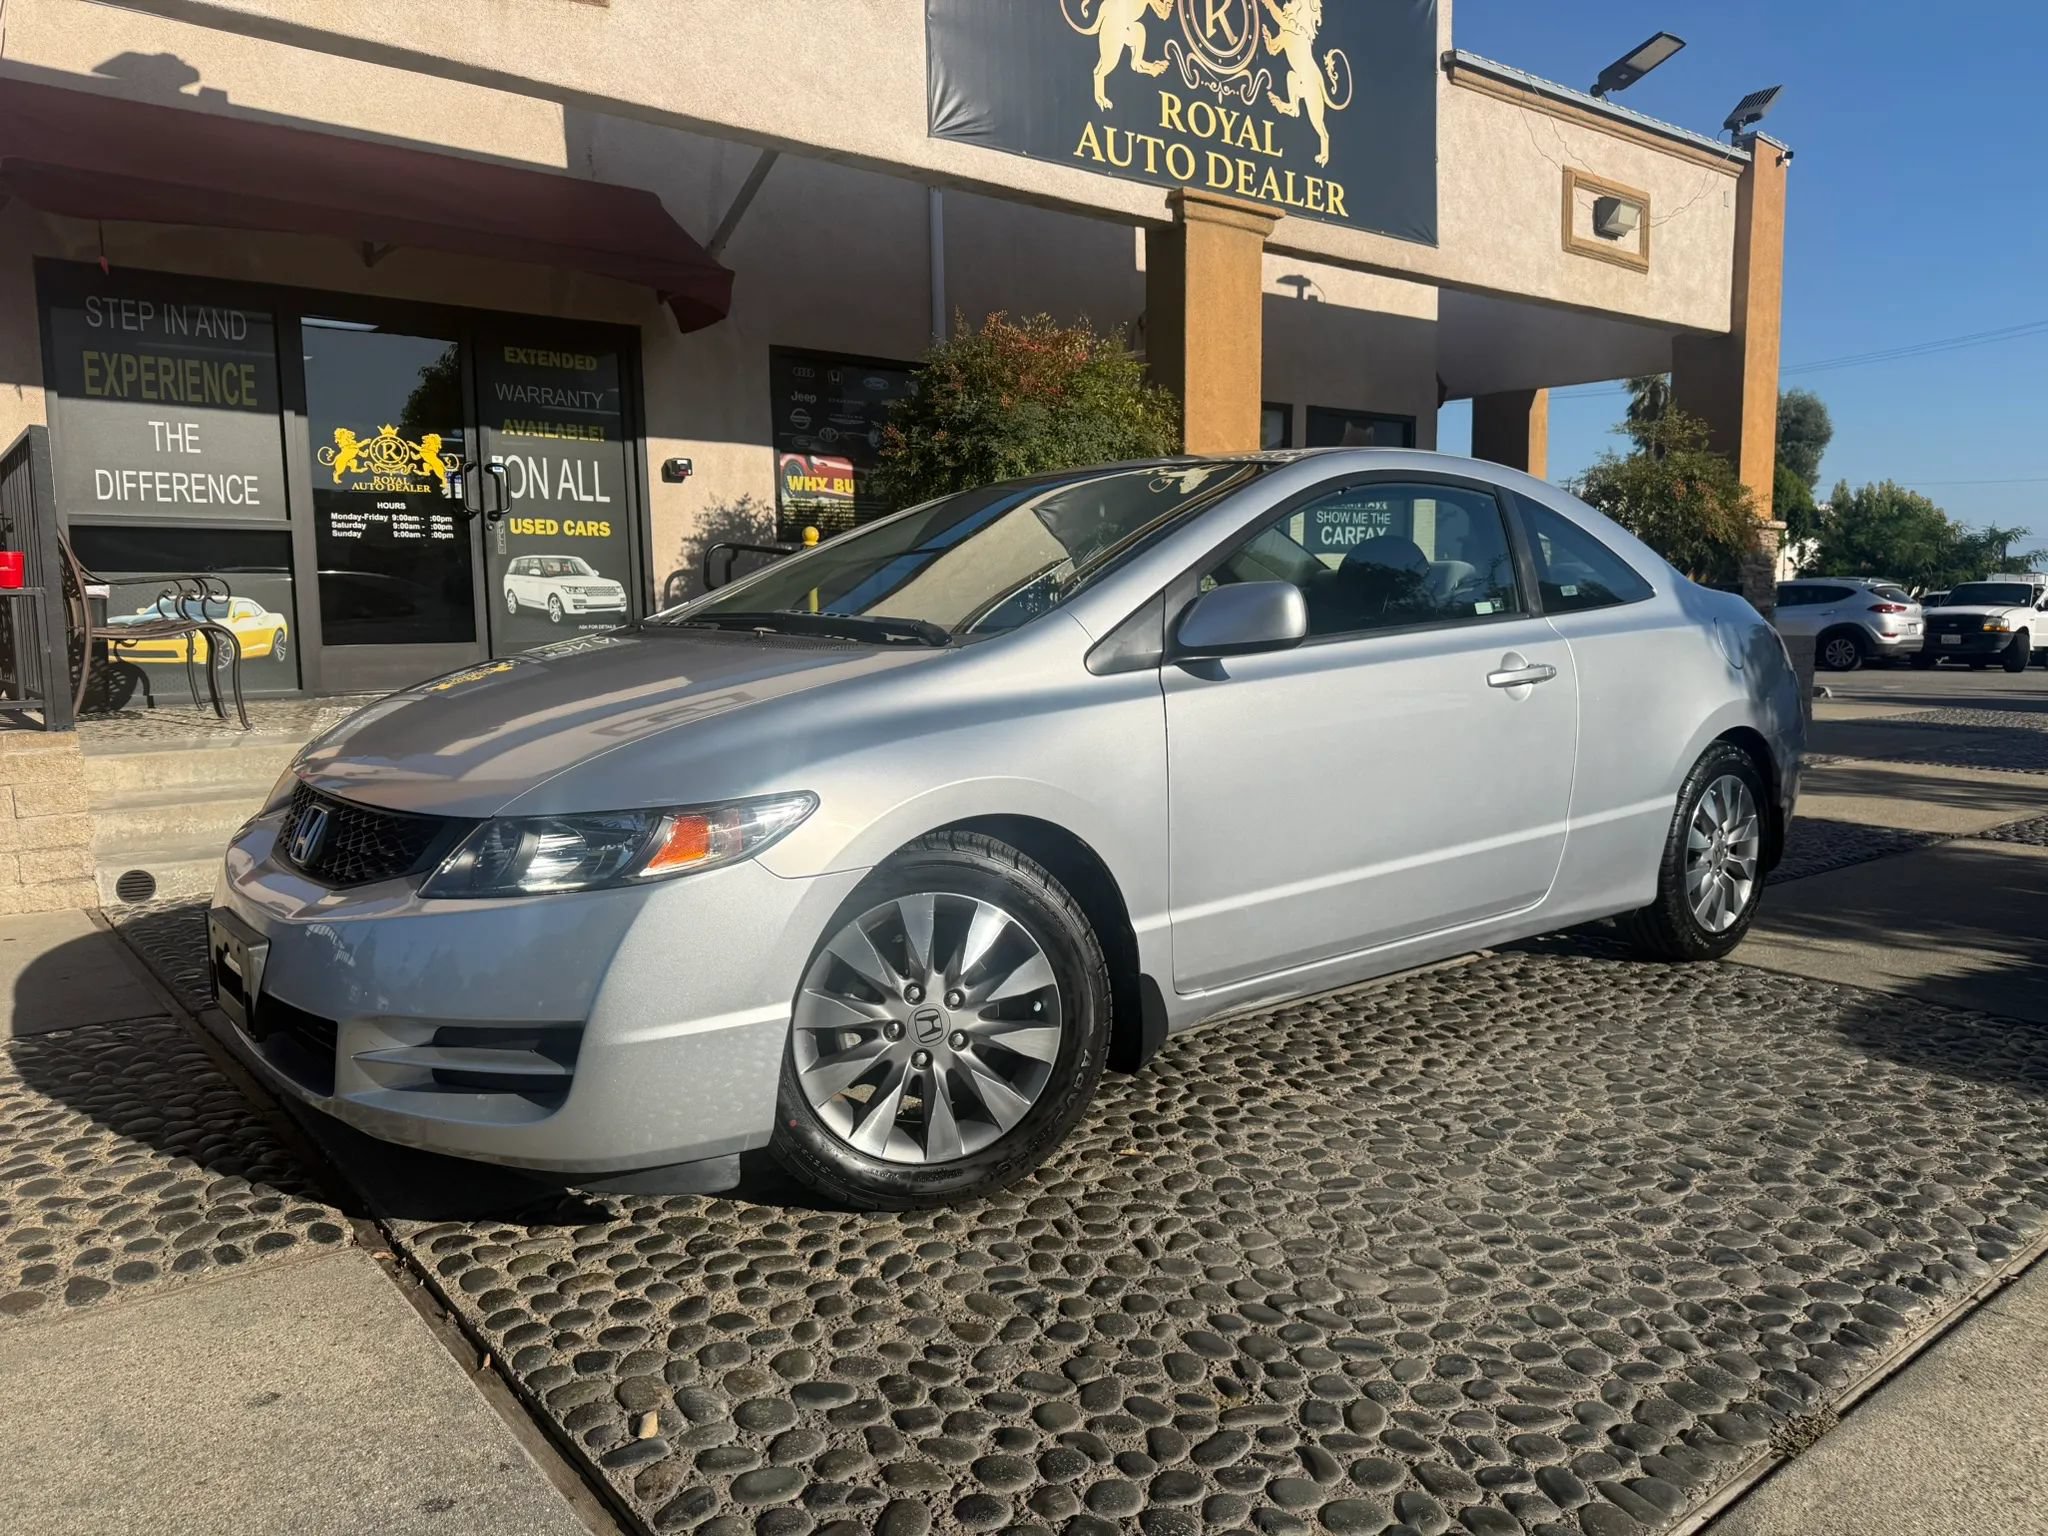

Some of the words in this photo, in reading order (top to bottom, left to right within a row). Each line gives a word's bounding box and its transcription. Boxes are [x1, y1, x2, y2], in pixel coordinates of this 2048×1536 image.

[1158, 90, 1283, 158] ROYAL
[1073, 121, 1196, 181] AUTO
[1205, 150, 1349, 217] DEALER
[85, 295, 154, 332] STEP
[163, 303, 189, 337] IN
[195, 307, 247, 341] AND
[503, 346, 598, 371] EXTENDED
[82, 350, 258, 406] EXPERIENCE
[495, 382, 604, 409] WARRANTY
[791, 391, 817, 405] Jeep
[148, 420, 201, 453] THE
[501, 418, 605, 442] AVAILABLE!
[95, 469, 260, 505] DIFFERENCE
[351, 482, 385, 491] AUTO
[387, 483, 432, 493] DEALER
[373, 475, 410, 486] ROYAL
[503, 454, 549, 500] ON
[557, 458, 611, 503] ALL
[787, 475, 828, 492] WHY
[377, 501, 407, 510] HOURS
[330, 512, 389, 522] Monday-Friday
[331, 521, 367, 530] Saturday
[509, 518, 559, 535] USED
[563, 520, 611, 537] CARS
[1316, 511, 1351, 524] SHOW
[1352, 512, 1369, 525] ME
[1370, 512, 1392, 525] THE
[331, 529, 362, 539] Sunday
